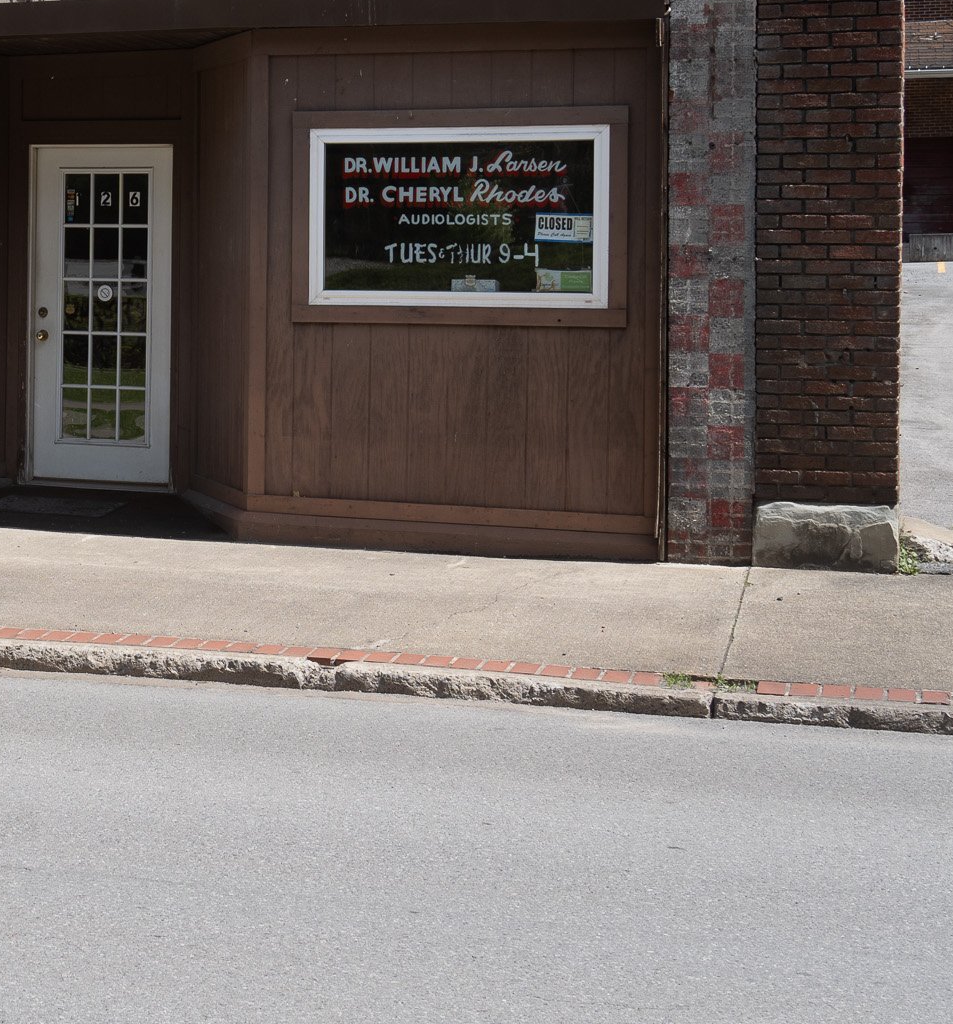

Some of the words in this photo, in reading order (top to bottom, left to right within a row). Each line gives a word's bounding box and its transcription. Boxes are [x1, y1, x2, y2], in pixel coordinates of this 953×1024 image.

[469, 156, 484, 173] J.
[487, 150, 568, 173] Larsen
[345, 186, 374, 204] DR.
[381, 186, 464, 203] CHERYL
[469, 178, 566, 204] Rhodes
[398, 213, 513, 226] AUDIOLOGISTS
[538, 217, 573, 231] CLOSED
[498, 242, 539, 267] 9-4
